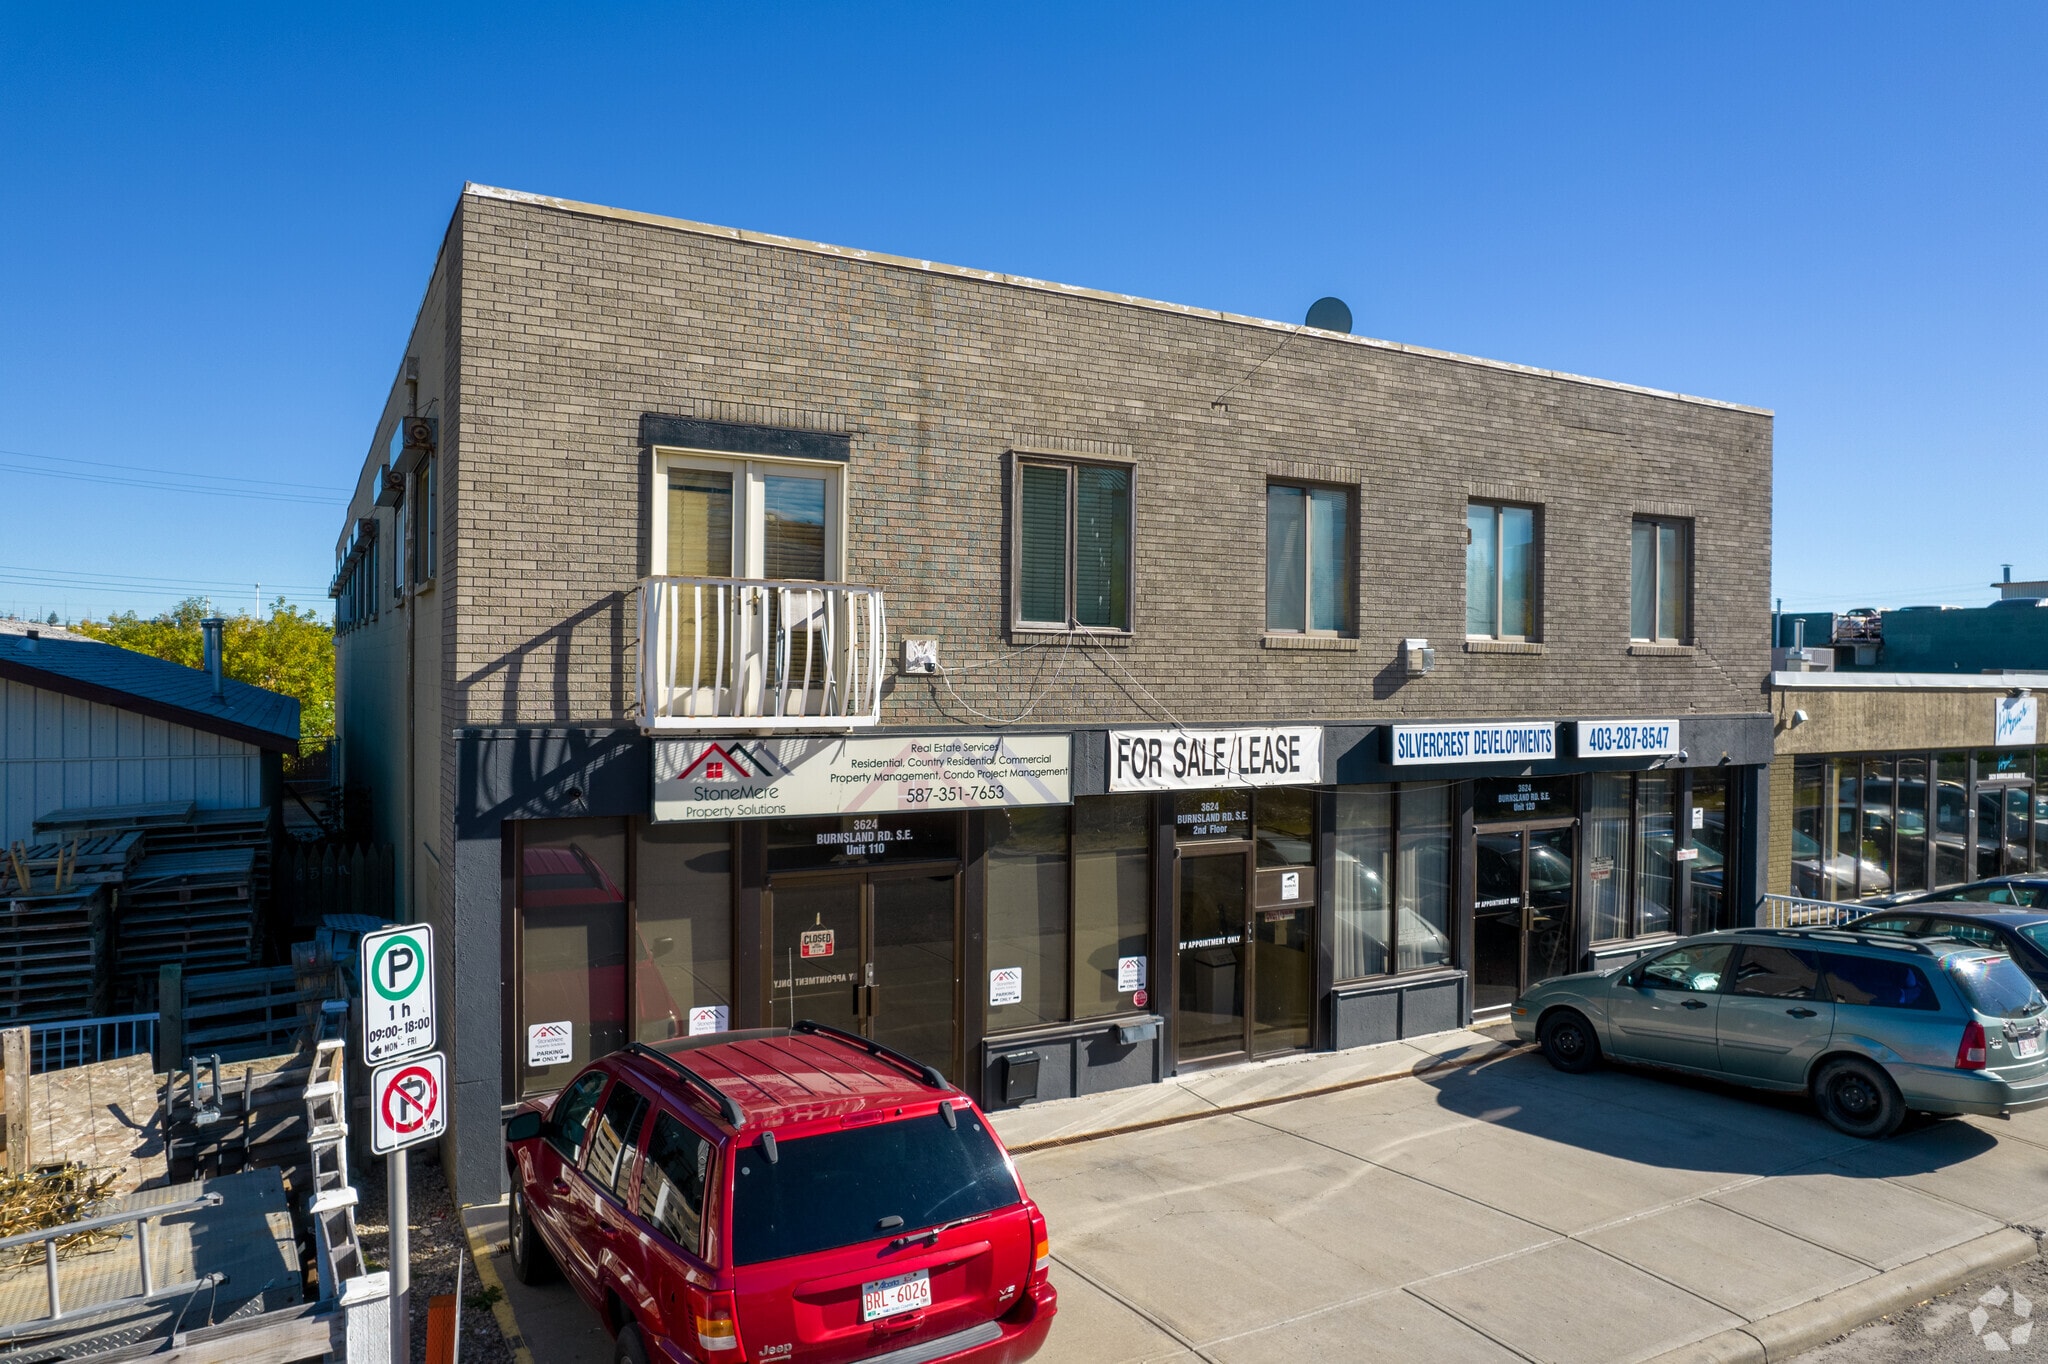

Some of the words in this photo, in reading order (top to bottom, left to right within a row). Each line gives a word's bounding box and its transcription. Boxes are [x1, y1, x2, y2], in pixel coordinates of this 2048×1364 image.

[1398, 731, 1470, 759] SILVERCREST
[1474, 729, 1552, 755] DEVELOPMENTS
[1589, 726, 1670, 751] 403-287-8547
[911, 743, 932, 753] Real
[934, 743, 961, 753] Estate
[963, 742, 1000, 752] Services
[851, 759, 905, 768] Residential,
[907, 758, 946, 768] Country
[946, 756, 996, 766] Residential,
[998, 754, 1052, 765] Commercial
[1117, 737, 1163, 780] FOR
[1173, 732, 1301, 780] SALE/LEASE
[830, 773, 871, 784] Property
[873, 771, 941, 783] Management,
[943, 770, 975, 780] Condo
[977, 769, 1008, 780] Project
[1009, 767, 1069, 779] Management
[694, 785, 779, 801] StoneMere
[906, 785, 1005, 803] 587-351-7653
[686, 806, 735, 818] Property
[737, 804, 786, 815] Solutions
[1200, 802, 1219, 812] 3624
[854, 819, 878, 830] 3624
[1177, 813, 1220, 824] BURNSLAND
[1222, 812, 1234, 821] RD.
[1235, 811, 1248, 820] S.E.
[1193, 825, 1207, 835] 2nd
[1209, 824, 1227, 834] Floor
[816, 832, 874, 844] BURNSLAND
[877, 831, 893, 842] RD.
[896, 830, 913, 841] S.E.
[847, 845, 866, 855] Unit
[868, 843, 885, 854] 110
[804, 934, 831, 944] CLOSED
[1179, 942, 1188, 950] BY
[1188, 937, 1226, 949] APPOINTMENT
[1227, 936, 1241, 944] ONLY
[388, 948, 414, 988] P
[389, 1005, 395, 1021] 1
[402, 1003, 411, 1018] h
[384, 1042, 398, 1053] MON
[407, 1036, 418, 1046] FRI
[536, 1049, 564, 1057] PARKING
[758, 1343, 793, 1357] Jeep
